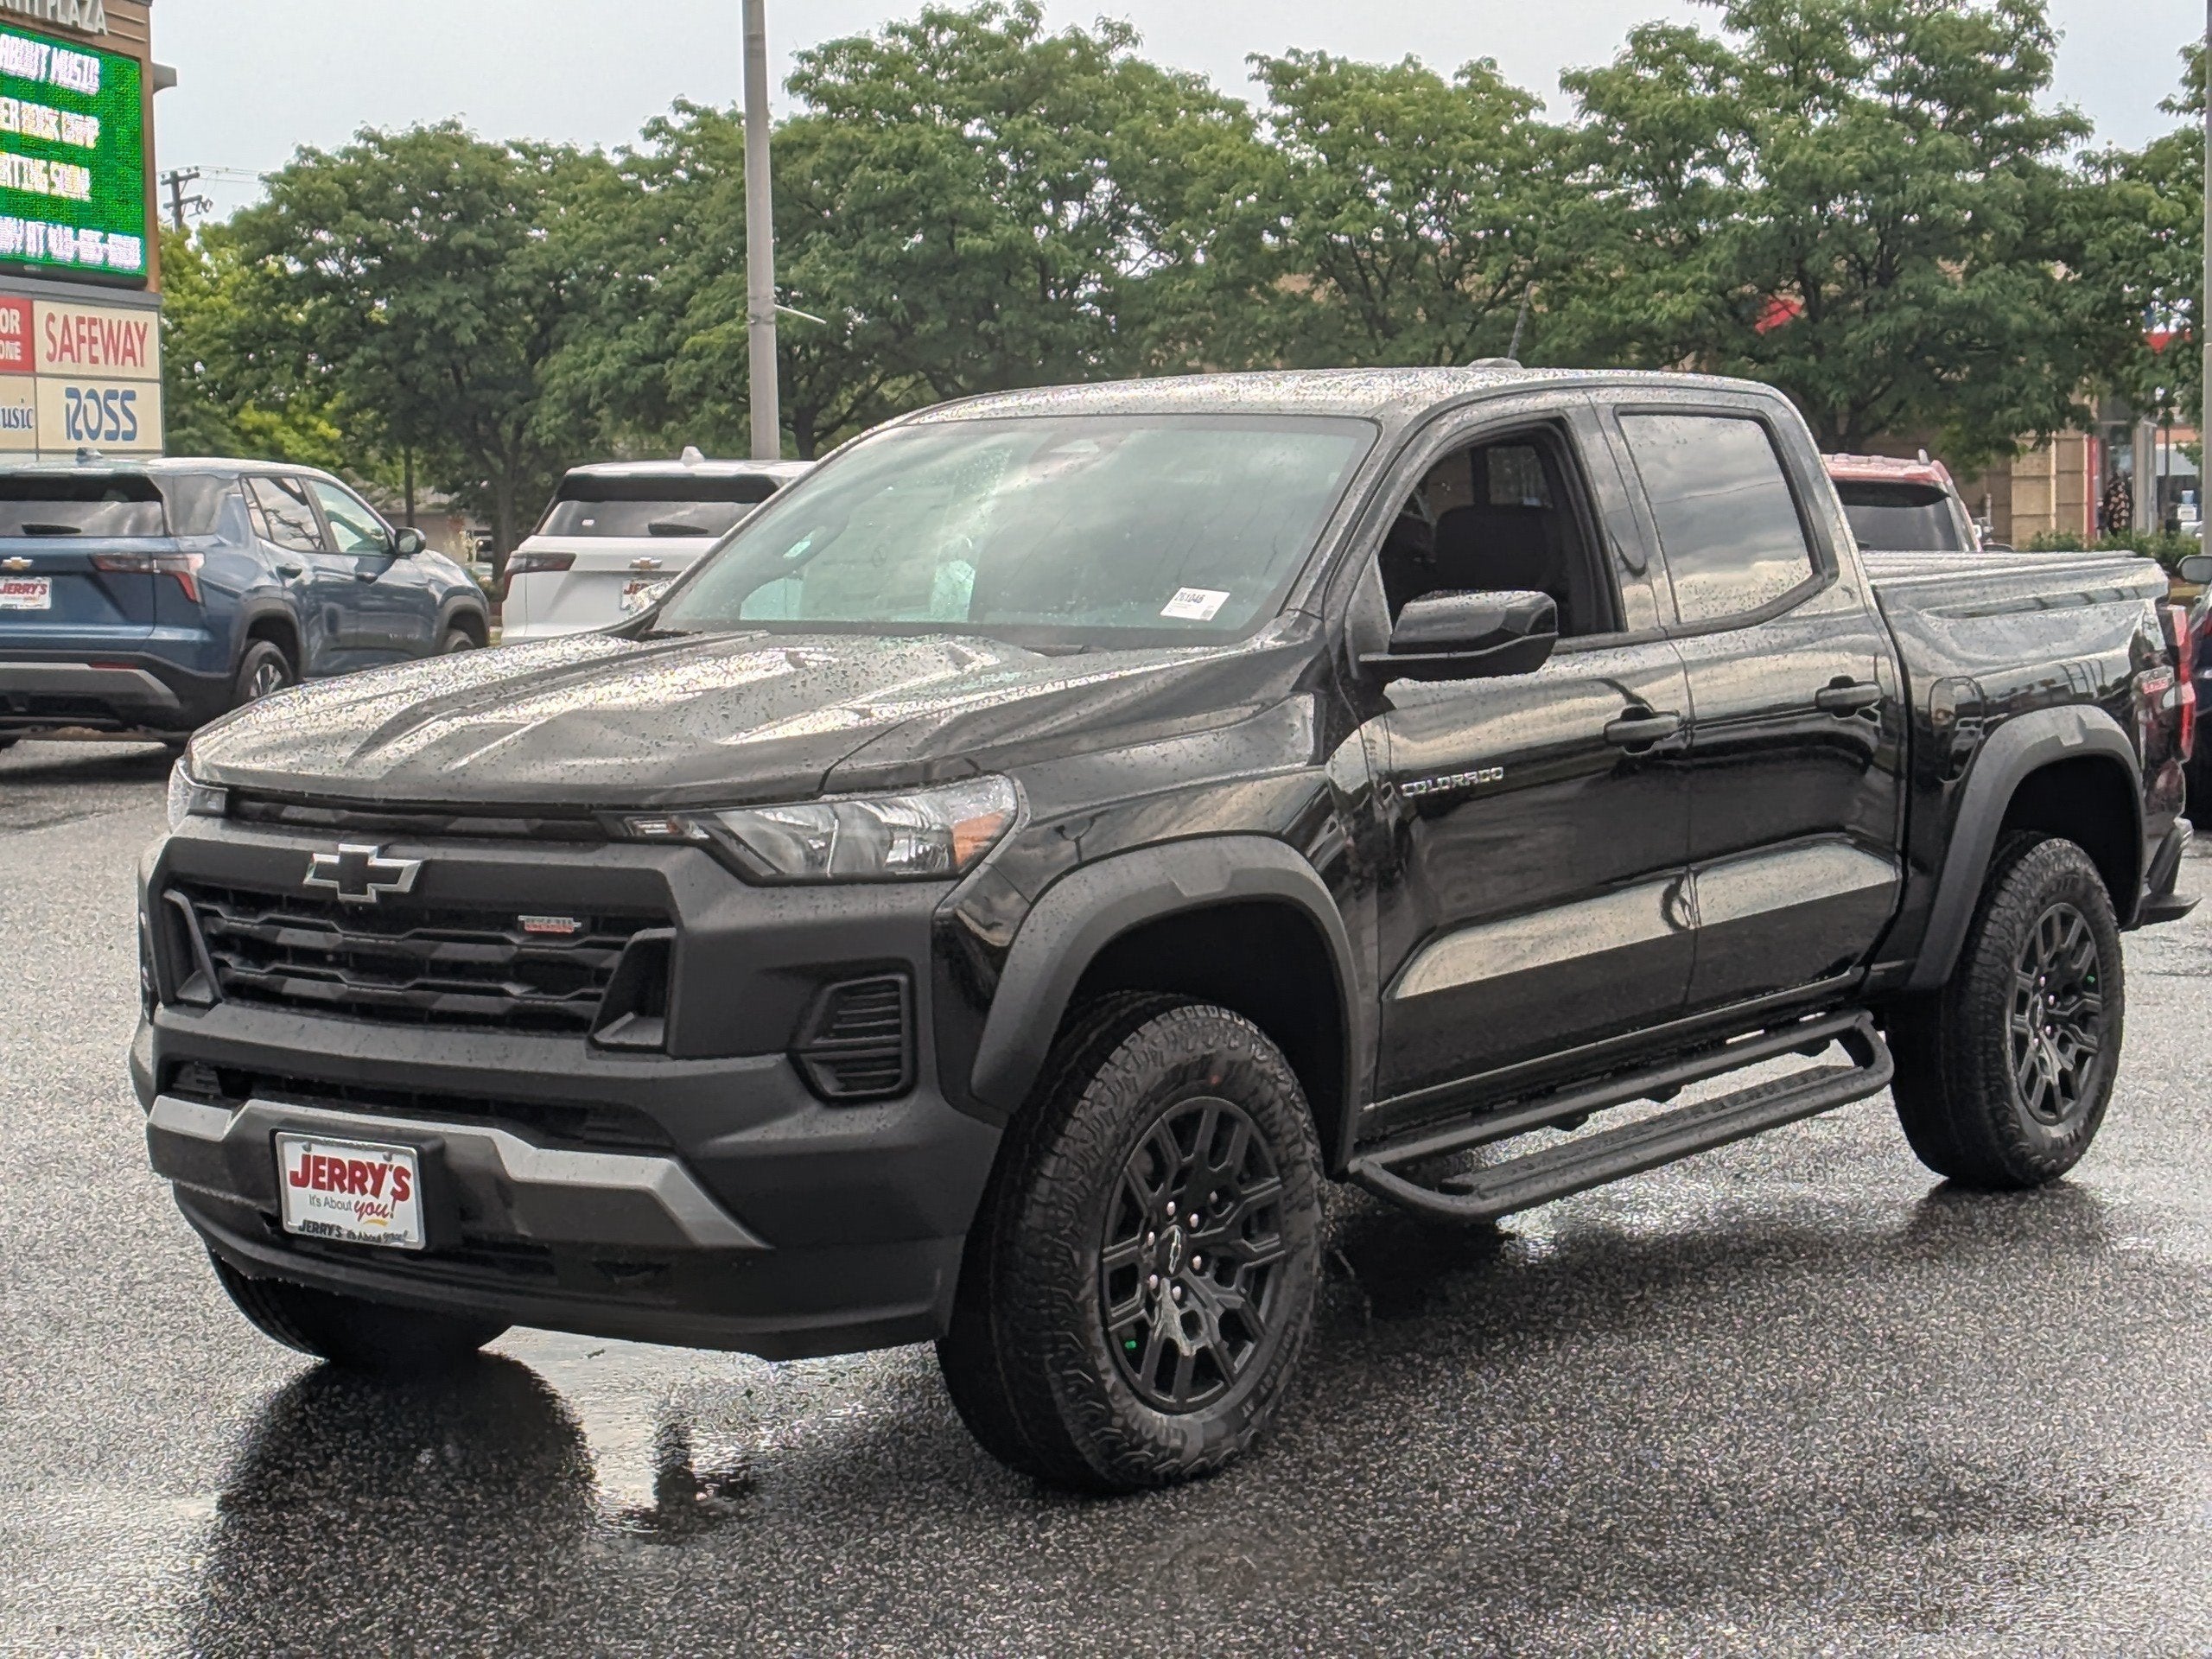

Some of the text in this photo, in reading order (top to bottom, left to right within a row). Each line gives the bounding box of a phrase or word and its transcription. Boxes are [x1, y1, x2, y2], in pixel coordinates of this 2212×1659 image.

[47, 0, 108, 35] PLAZA
[45, 312, 149, 368] SAFEWAY
[65, 386, 137, 442] ROSS
[1401, 766, 1503, 797] COLORADO
[289, 1154, 411, 1202] JERRY'S
[309, 1193, 397, 1223] It's About you!
